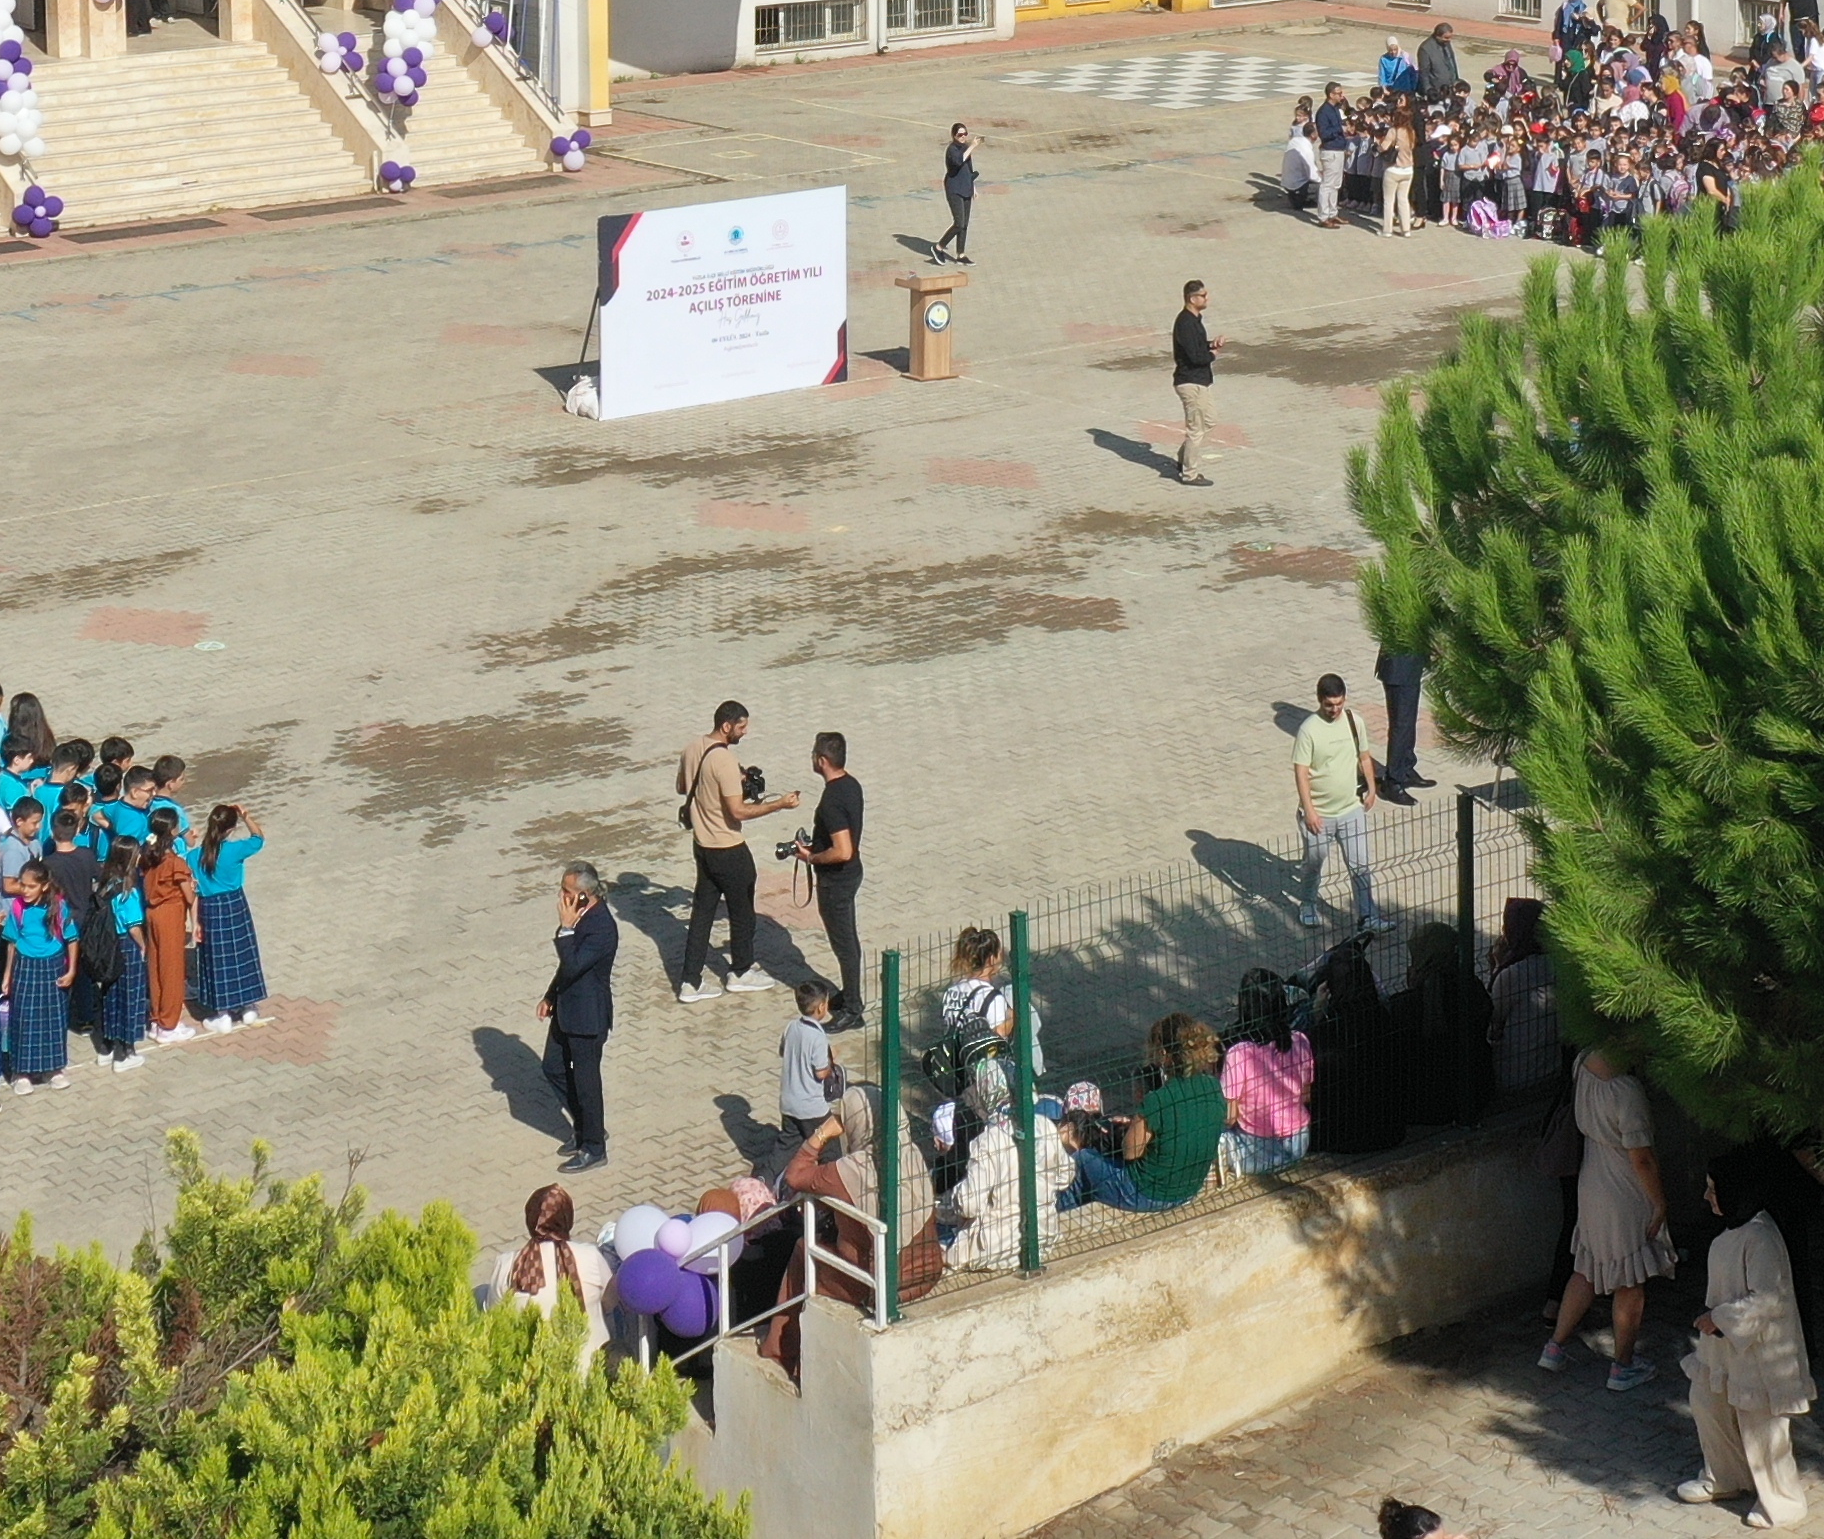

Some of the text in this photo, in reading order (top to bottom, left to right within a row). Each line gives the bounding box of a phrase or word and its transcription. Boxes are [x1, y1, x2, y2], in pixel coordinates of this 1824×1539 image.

[646, 266, 823, 302] 2024-2025 EĞİTİM ÖĞRETİM YILI
[689, 289, 782, 316] AÇILIŞ TÖRENİNE
